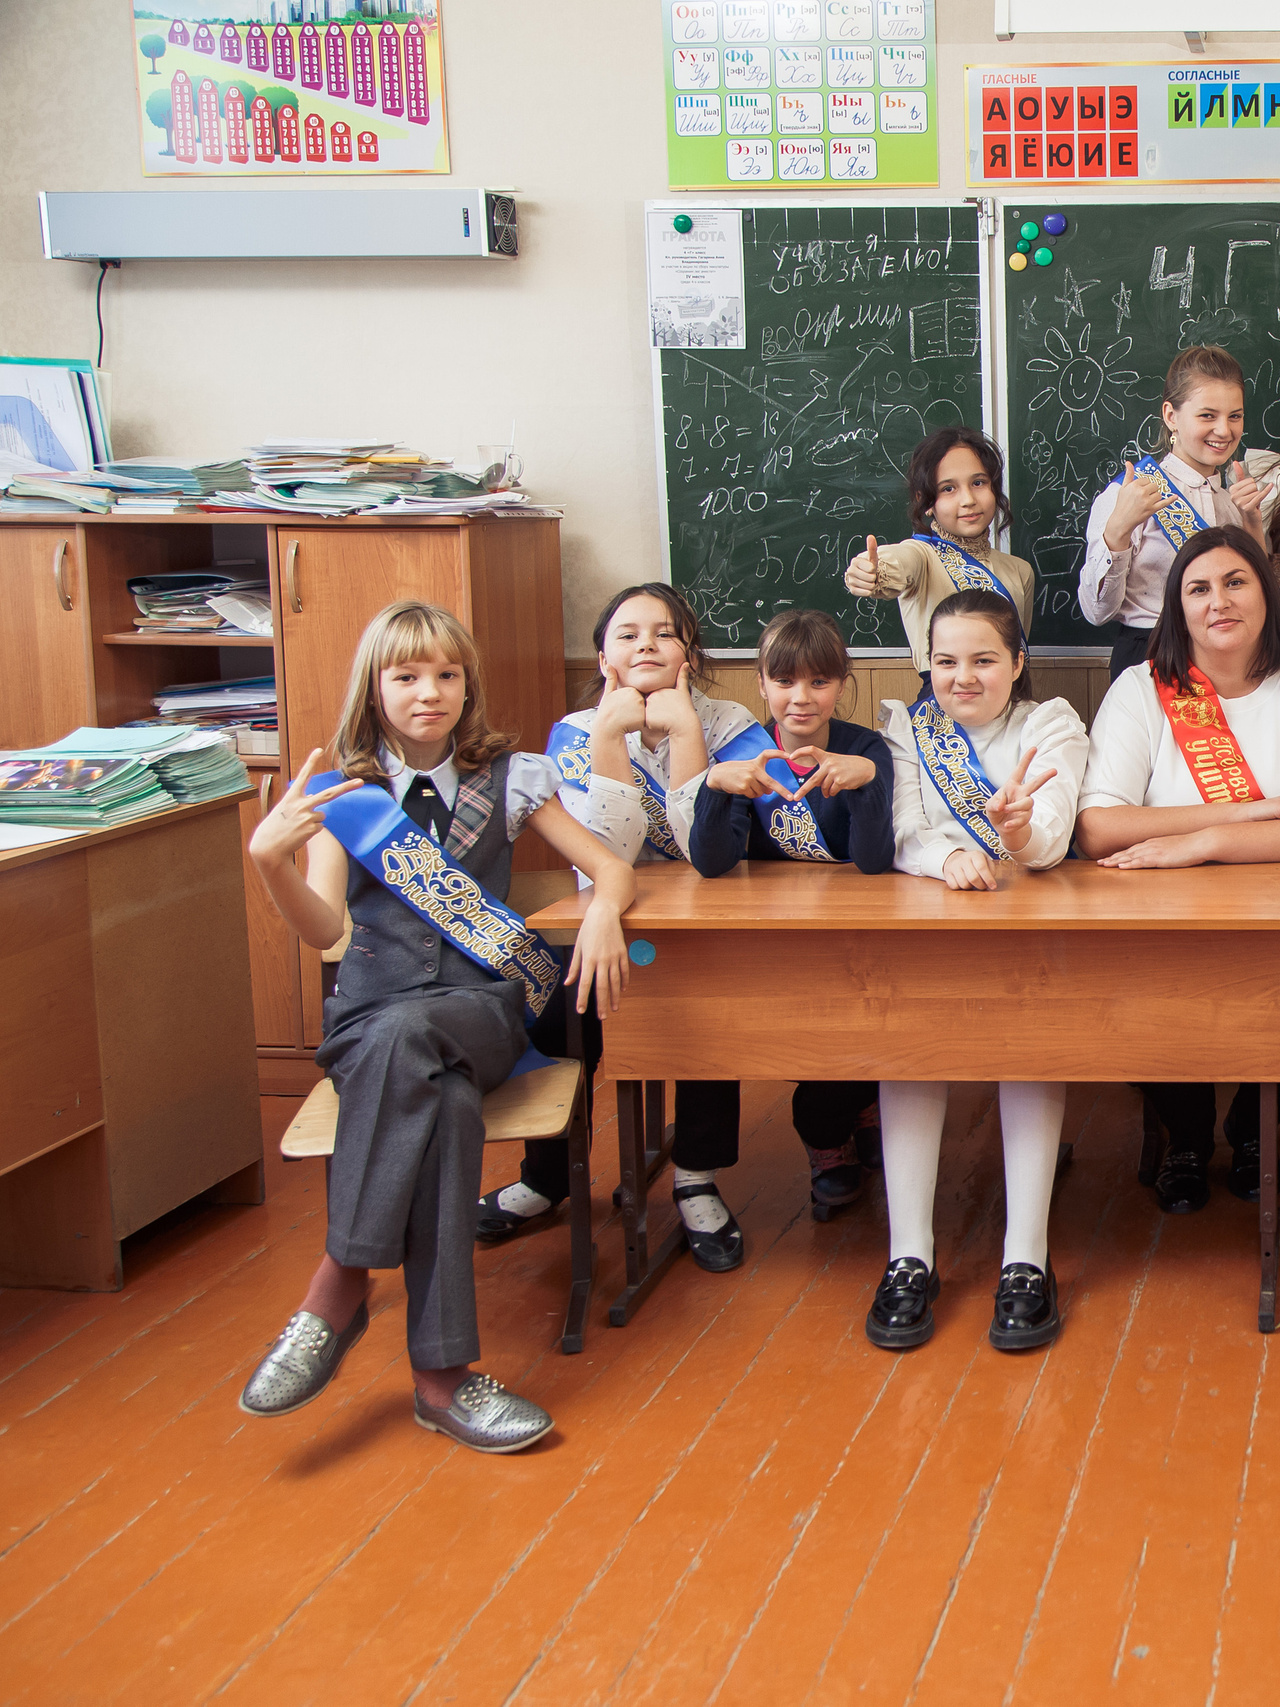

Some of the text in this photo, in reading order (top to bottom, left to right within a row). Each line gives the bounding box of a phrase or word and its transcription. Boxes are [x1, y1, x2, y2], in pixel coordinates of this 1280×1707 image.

[676, 2, 901, 19] Оо Пп Рр Сс Тт
[679, 48, 904, 66] Уу Фф Хх Цц Чч
[982, 73, 1037, 84] ГЛАСНЫЕ
[1168, 70, 1241, 81] СОГЛАСНЫЕ
[678, 95, 906, 110] Шш Щщ Ъъ Ыы Ьь
[988, 96, 1131, 120] А О У Ы Э
[1175, 92, 1192, 121] Й
[1205, 95, 1224, 118] Л
[1234, 94, 1259, 117] М
[732, 143, 750, 156] Ээ
[780, 144, 806, 155] Юю
[832, 142, 851, 154] Яя
[991, 139, 1131, 166] Я Ё Ю И Е
[662, 231, 727, 242] ГРАМОТА
[915, 728, 977, 819] начальной
[401, 880, 512, 970] начальной
[427, 867, 563, 1001] Выпускник
